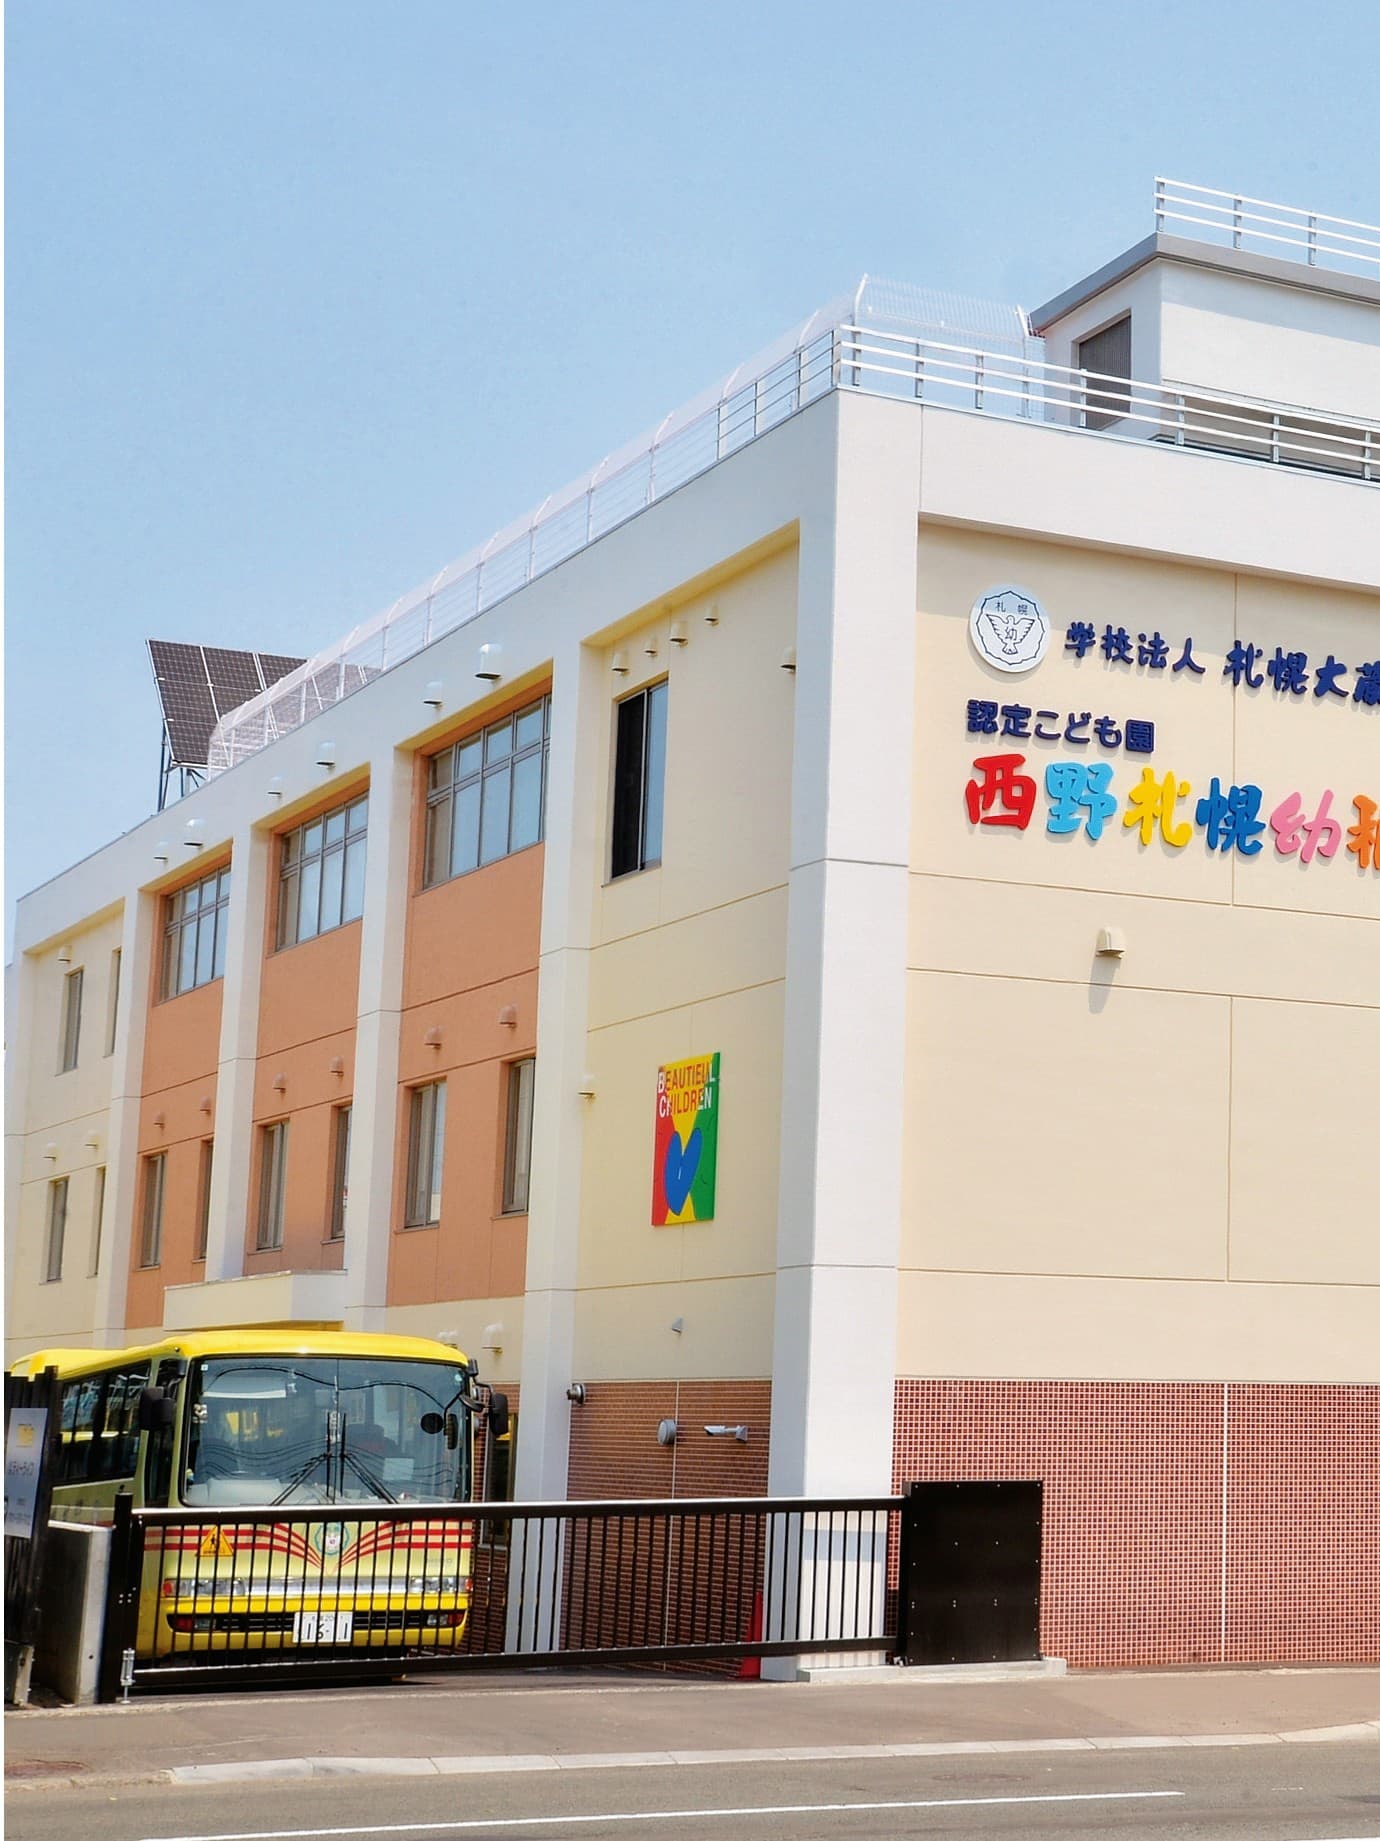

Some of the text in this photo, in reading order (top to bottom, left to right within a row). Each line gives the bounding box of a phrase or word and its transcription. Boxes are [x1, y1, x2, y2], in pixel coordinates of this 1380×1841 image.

[1065, 621, 1206, 675] 学校法人
[967, 699, 1155, 753] 認定こども園
[659, 1087, 712, 1118] CHILDREN
